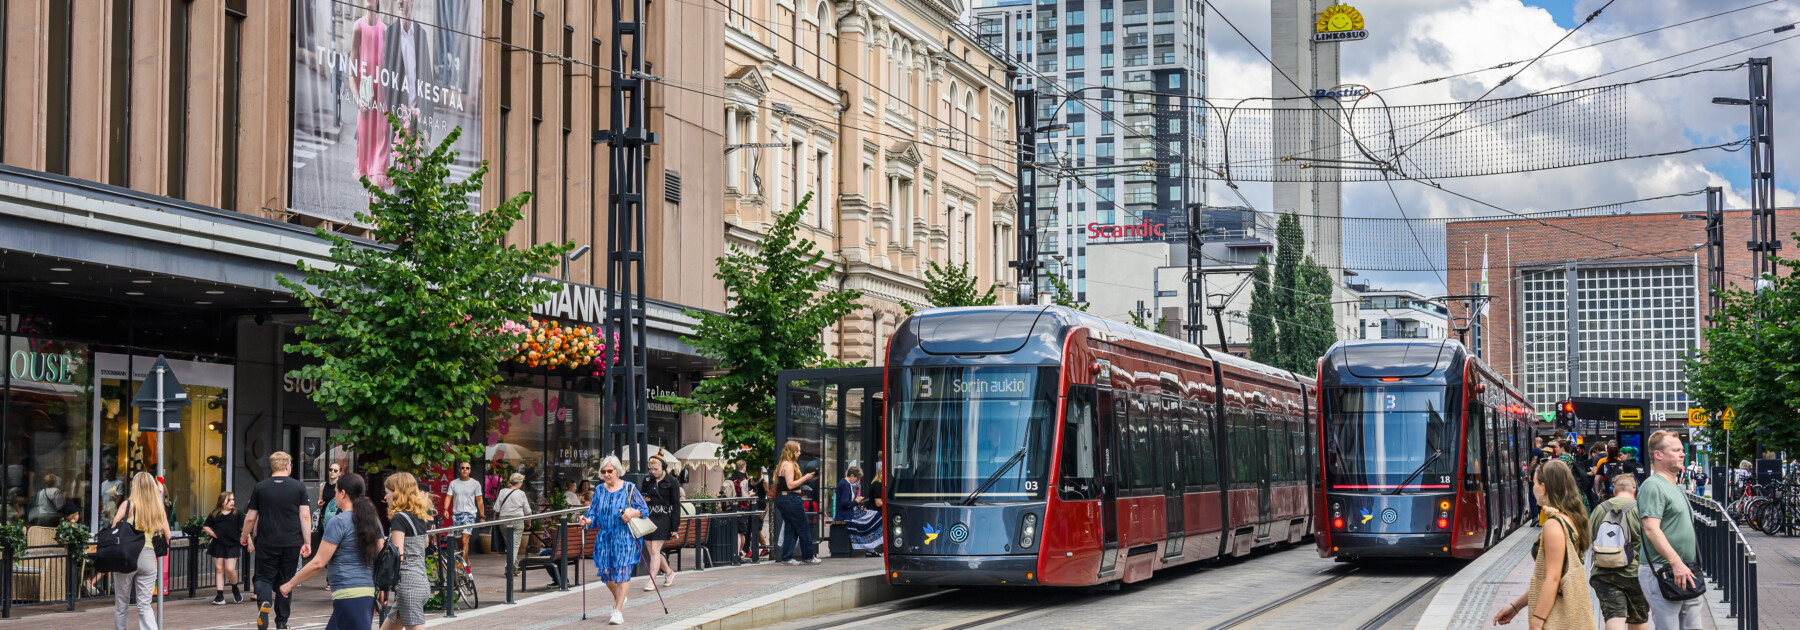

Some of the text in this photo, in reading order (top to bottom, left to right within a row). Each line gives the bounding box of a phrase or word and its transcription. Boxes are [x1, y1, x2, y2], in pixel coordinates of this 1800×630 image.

[1315, 31, 1366, 41] LINKOSUO
[317, 46, 464, 112] TUNNE JOKA KESTÄÄ
[1314, 87, 1363, 99] Bostik
[340, 88, 385, 113] KÄNLAN
[1088, 219, 1164, 239] Scandic
[920, 376, 1025, 398] 3 Sorin aukio
[1386, 394, 1396, 410] 3
[1693, 413, 1702, 421] 40
[1024, 481, 1038, 491] 03
[1439, 475, 1451, 484] 18
